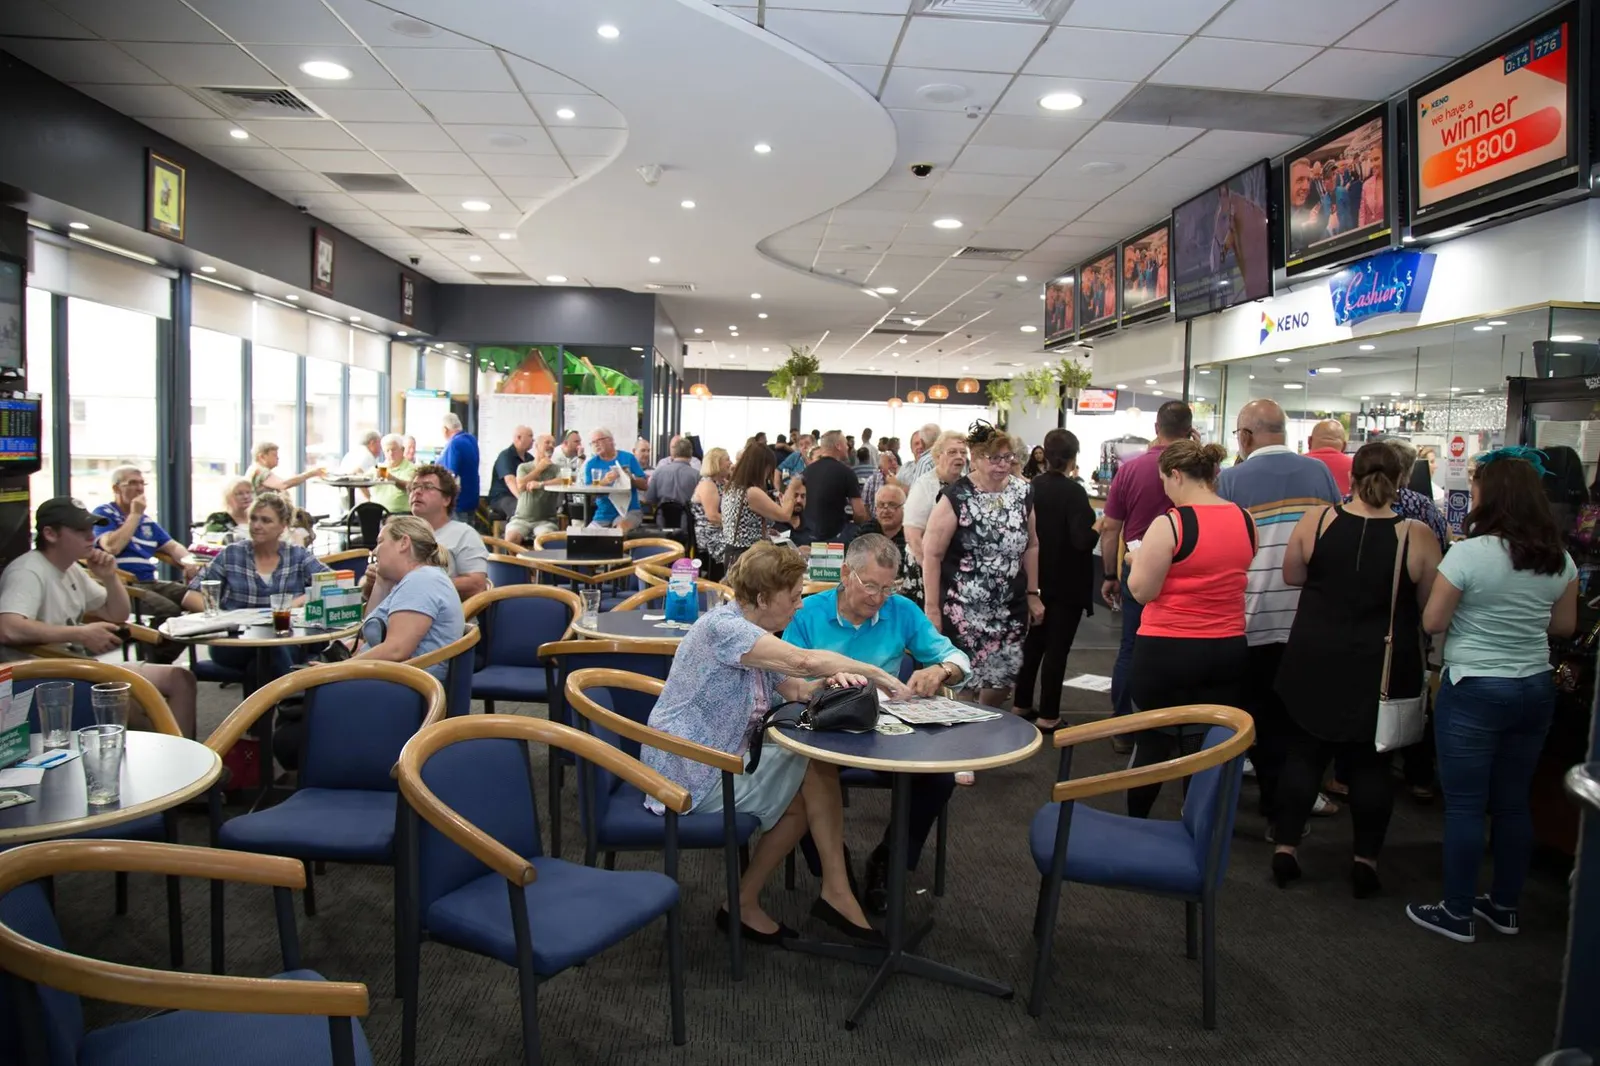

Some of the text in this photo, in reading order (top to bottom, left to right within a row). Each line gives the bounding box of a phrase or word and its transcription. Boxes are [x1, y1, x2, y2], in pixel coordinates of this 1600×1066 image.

[1536, 38, 1557, 57] 776
[1505, 53, 1528, 73] 0:14
[1431, 95, 1450, 109] KENO
[1431, 113, 1443, 126] we
[1445, 104, 1466, 119] have
[1468, 99, 1474, 109] a
[1441, 95, 1519, 147] winner
[1455, 128, 1517, 173] $1,800
[1345, 271, 1396, 311] Cashier
[1277, 311, 1310, 332] KENO
[1450, 442, 1465, 451] STOP
[1450, 511, 1465, 522] LIVE
[812, 569, 839, 577] Bet here.
[307, 604, 322, 616] TAB
[329, 610, 358, 621] Bet here.
